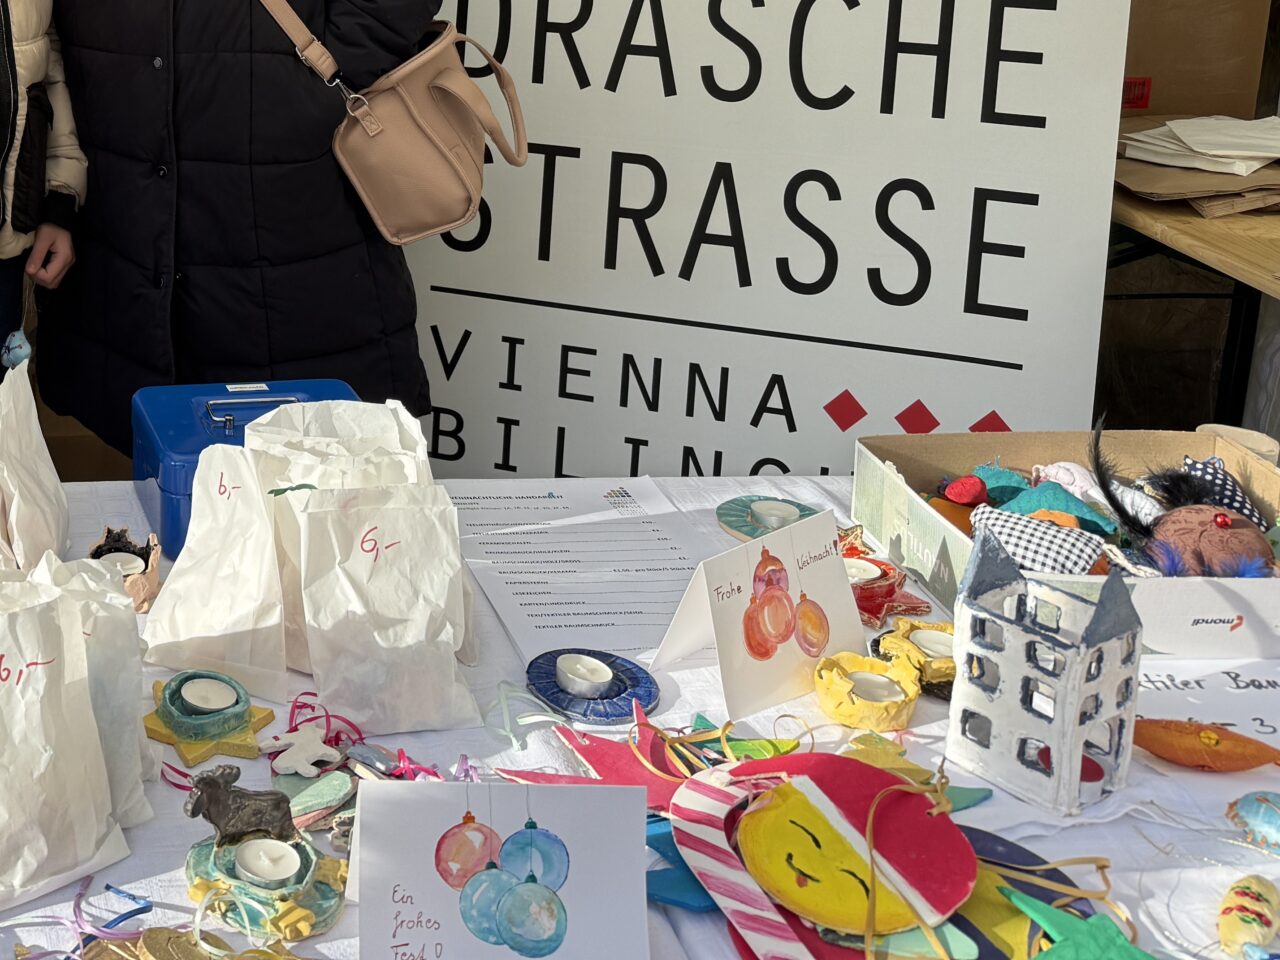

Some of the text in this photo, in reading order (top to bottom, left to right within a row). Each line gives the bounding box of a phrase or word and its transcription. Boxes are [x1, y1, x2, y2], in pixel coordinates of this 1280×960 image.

[430, 324, 797, 432] VIENNA
[713, 582, 743, 603] Frohe
[1191, 618, 1235, 627] mondi
[391, 884, 415, 905] Ein
[392, 910, 441, 939] frohes
